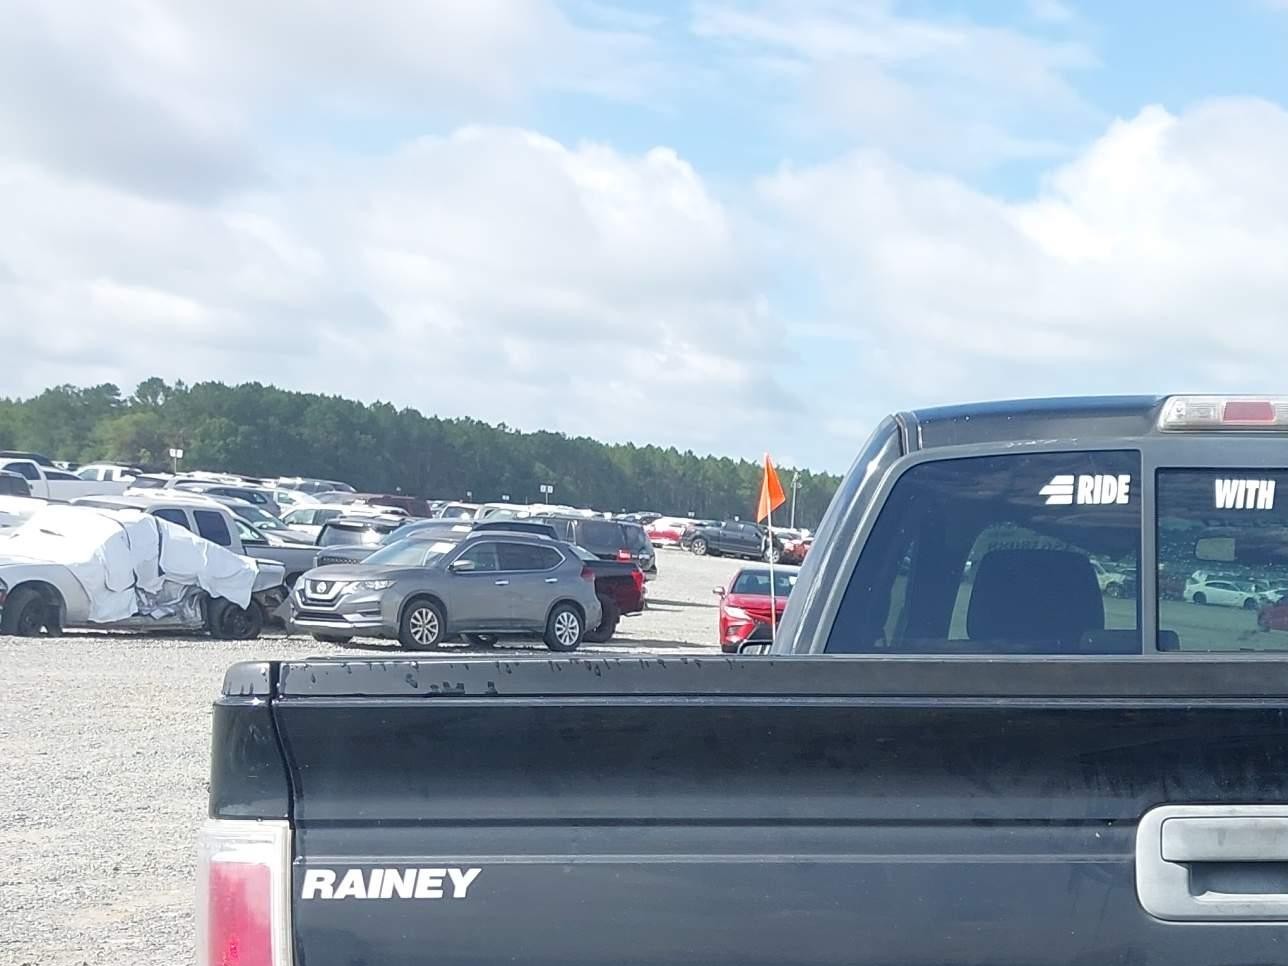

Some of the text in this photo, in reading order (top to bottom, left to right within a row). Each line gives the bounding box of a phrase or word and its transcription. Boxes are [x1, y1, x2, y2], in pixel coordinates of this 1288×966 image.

[1077, 474, 1131, 505] RIDE
[1215, 479, 1276, 510] WITH
[301, 868, 481, 899] RAINEY
